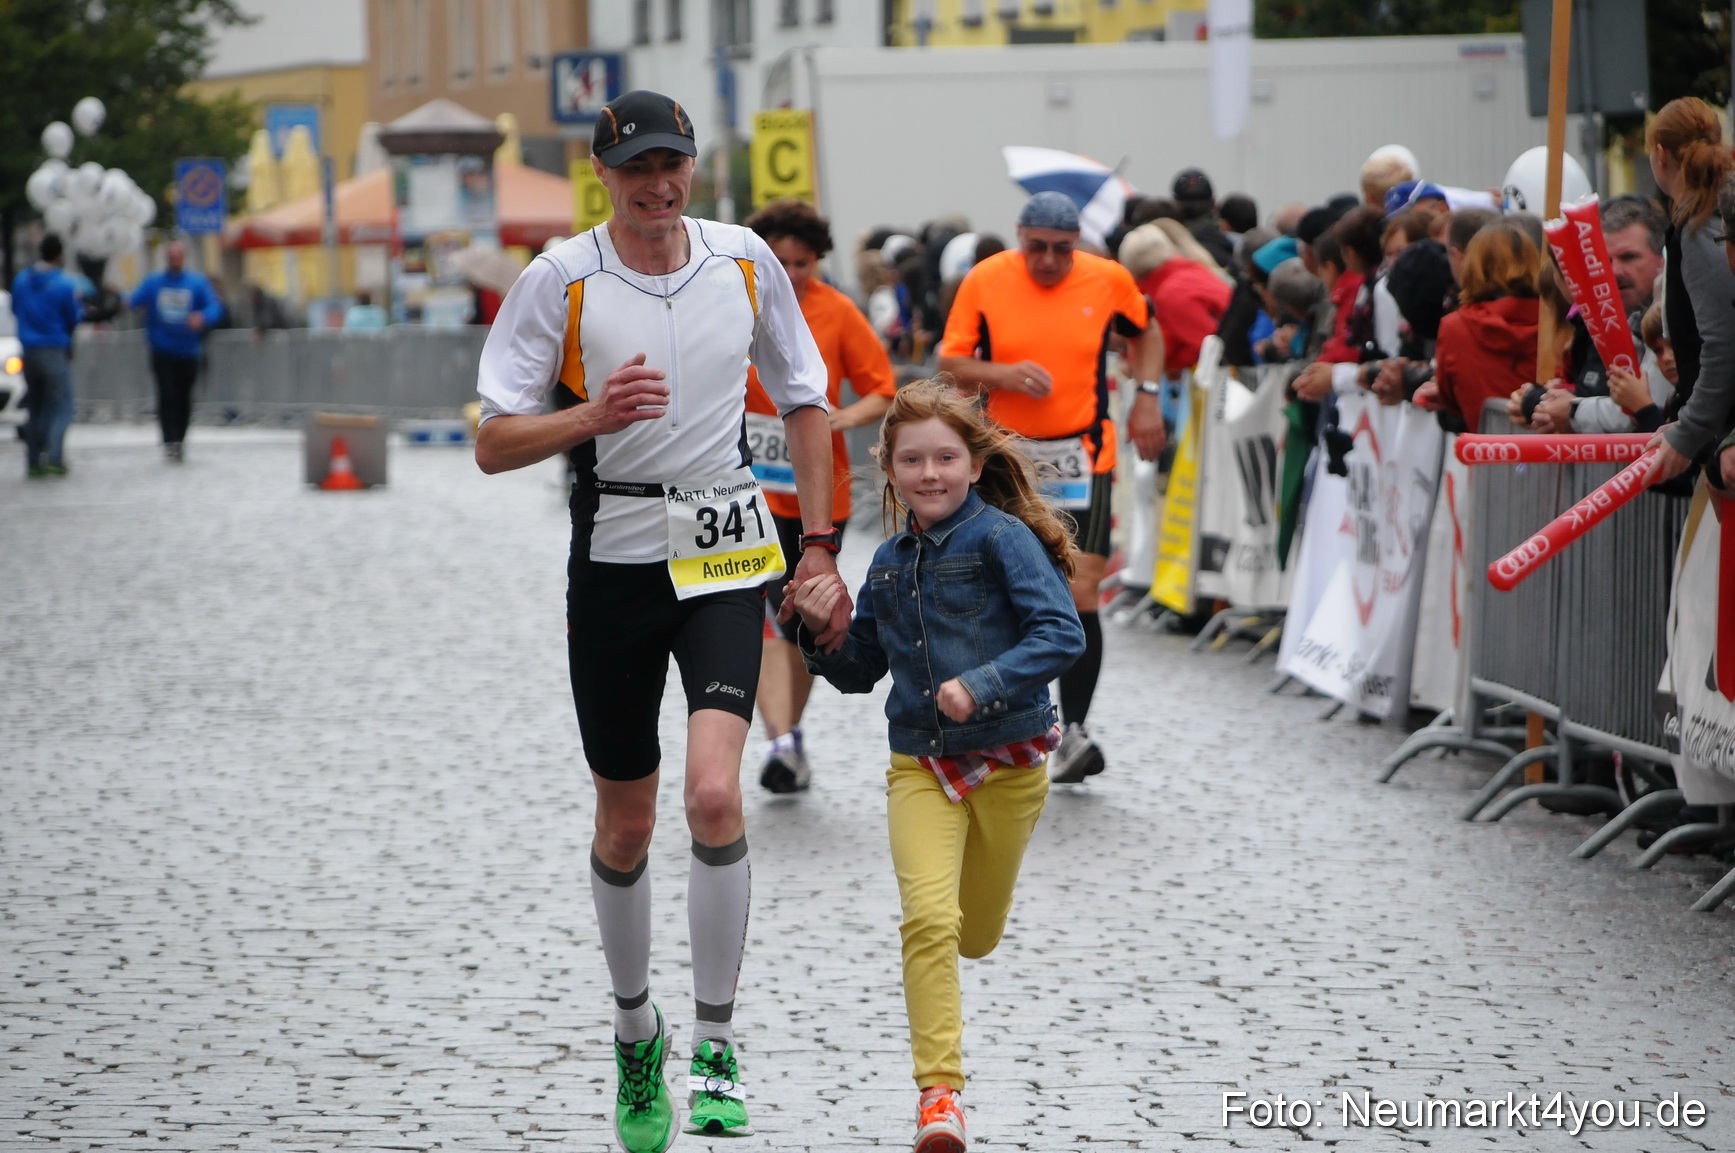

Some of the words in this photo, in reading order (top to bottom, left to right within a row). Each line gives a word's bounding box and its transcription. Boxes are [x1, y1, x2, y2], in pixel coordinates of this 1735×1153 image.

[768, 138, 798, 184] C
[1573, 220, 1605, 278] Audi
[1592, 282, 1621, 333] BKK
[1544, 444, 1596, 460] BKK
[1606, 444, 1646, 460] udi
[667, 489, 711, 504] PARTL
[695, 494, 765, 549] 341
[1562, 488, 1612, 531] BKK
[703, 555, 767, 579] Andreas
[719, 684, 746, 698] asics
